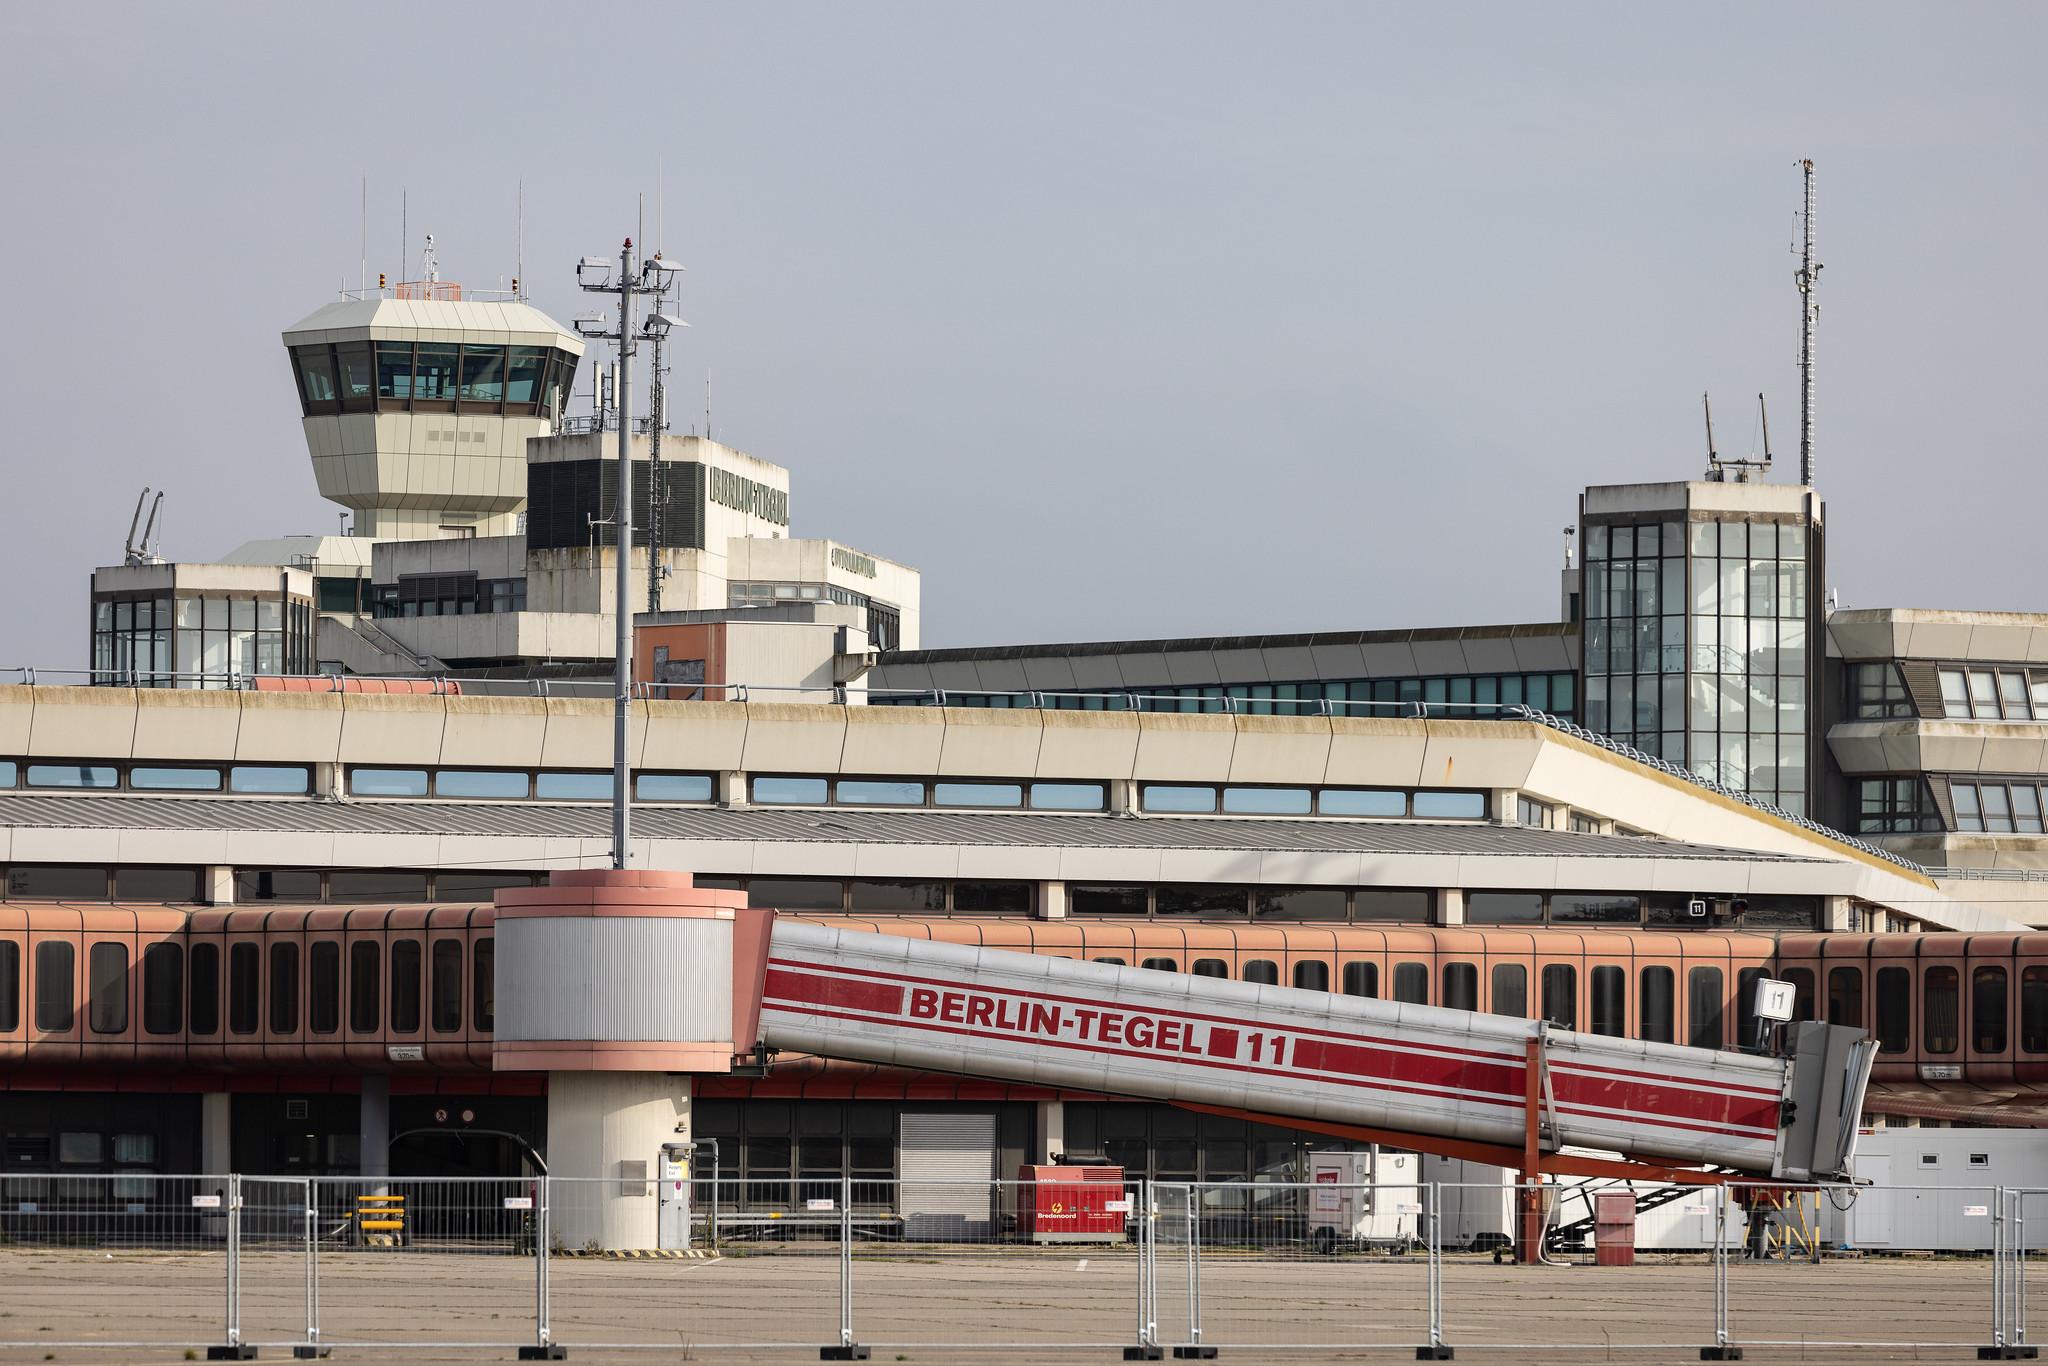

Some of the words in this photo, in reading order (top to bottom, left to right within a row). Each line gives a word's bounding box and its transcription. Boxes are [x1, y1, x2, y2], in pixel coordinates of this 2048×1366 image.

[1693, 904, 1702, 913] 11
[1771, 990, 1785, 1010] 11
[909, 988, 1202, 1055] BERLIN-TEGEL
[1246, 1032, 1286, 1066] 11
[1037, 1212, 1077, 1220] Bredenoord
